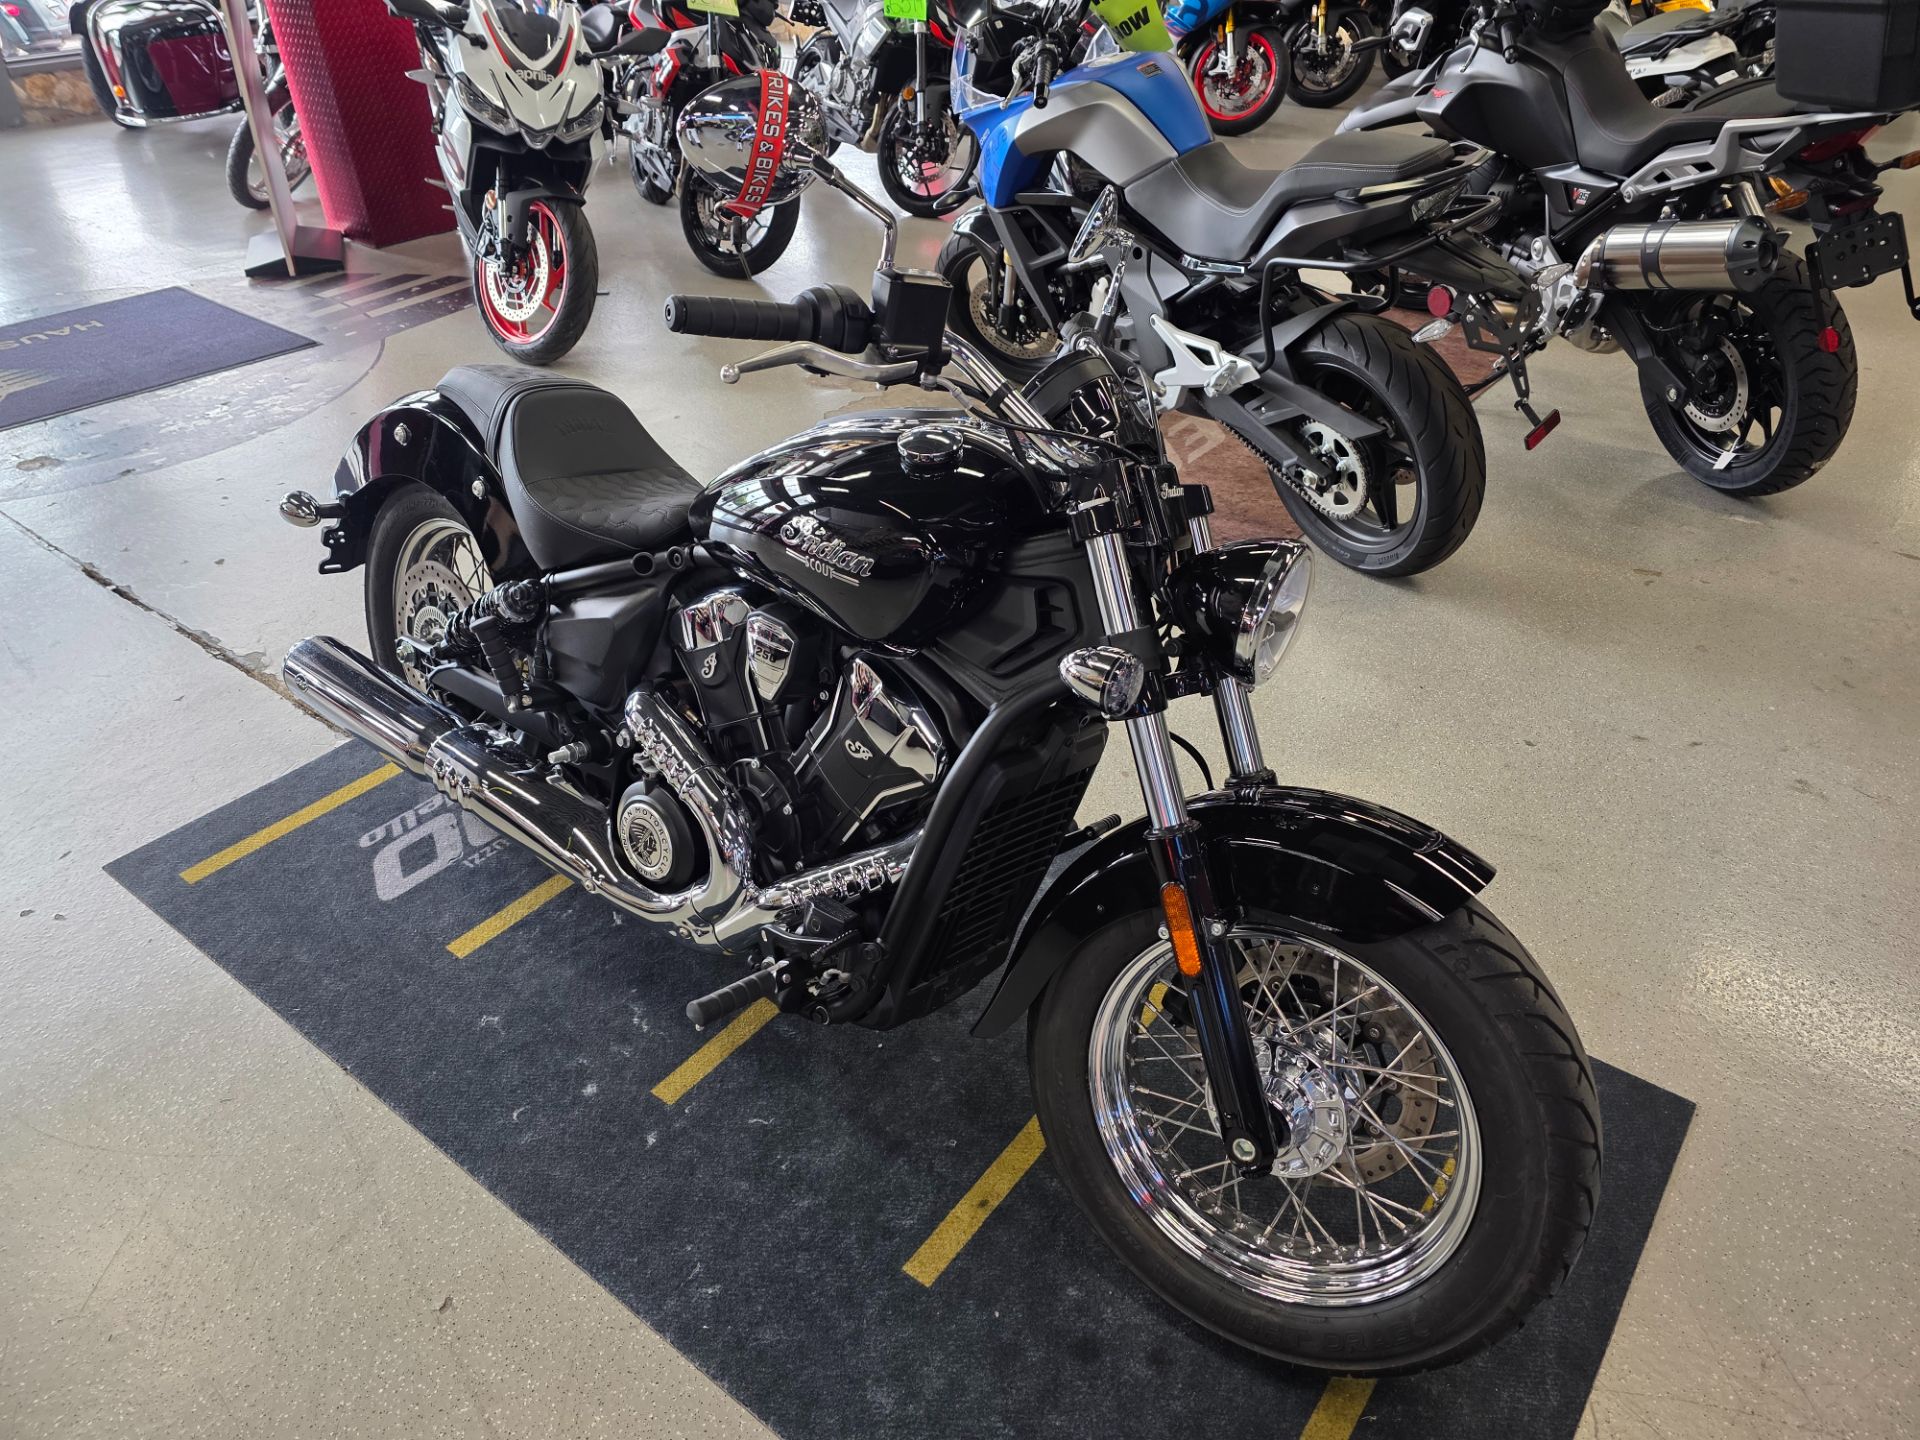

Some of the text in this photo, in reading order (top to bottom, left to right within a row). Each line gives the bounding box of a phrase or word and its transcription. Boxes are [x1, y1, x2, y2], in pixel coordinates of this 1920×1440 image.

[516, 69, 555, 83] aprilia
[745, 69, 784, 203] TRIKES & BIKES
[1160, 482, 1184, 500] Indian
[780, 514, 875, 577] Indian
[804, 556, 834, 579] SCOUT
[635, 806, 669, 874] MOTORCYCLE
